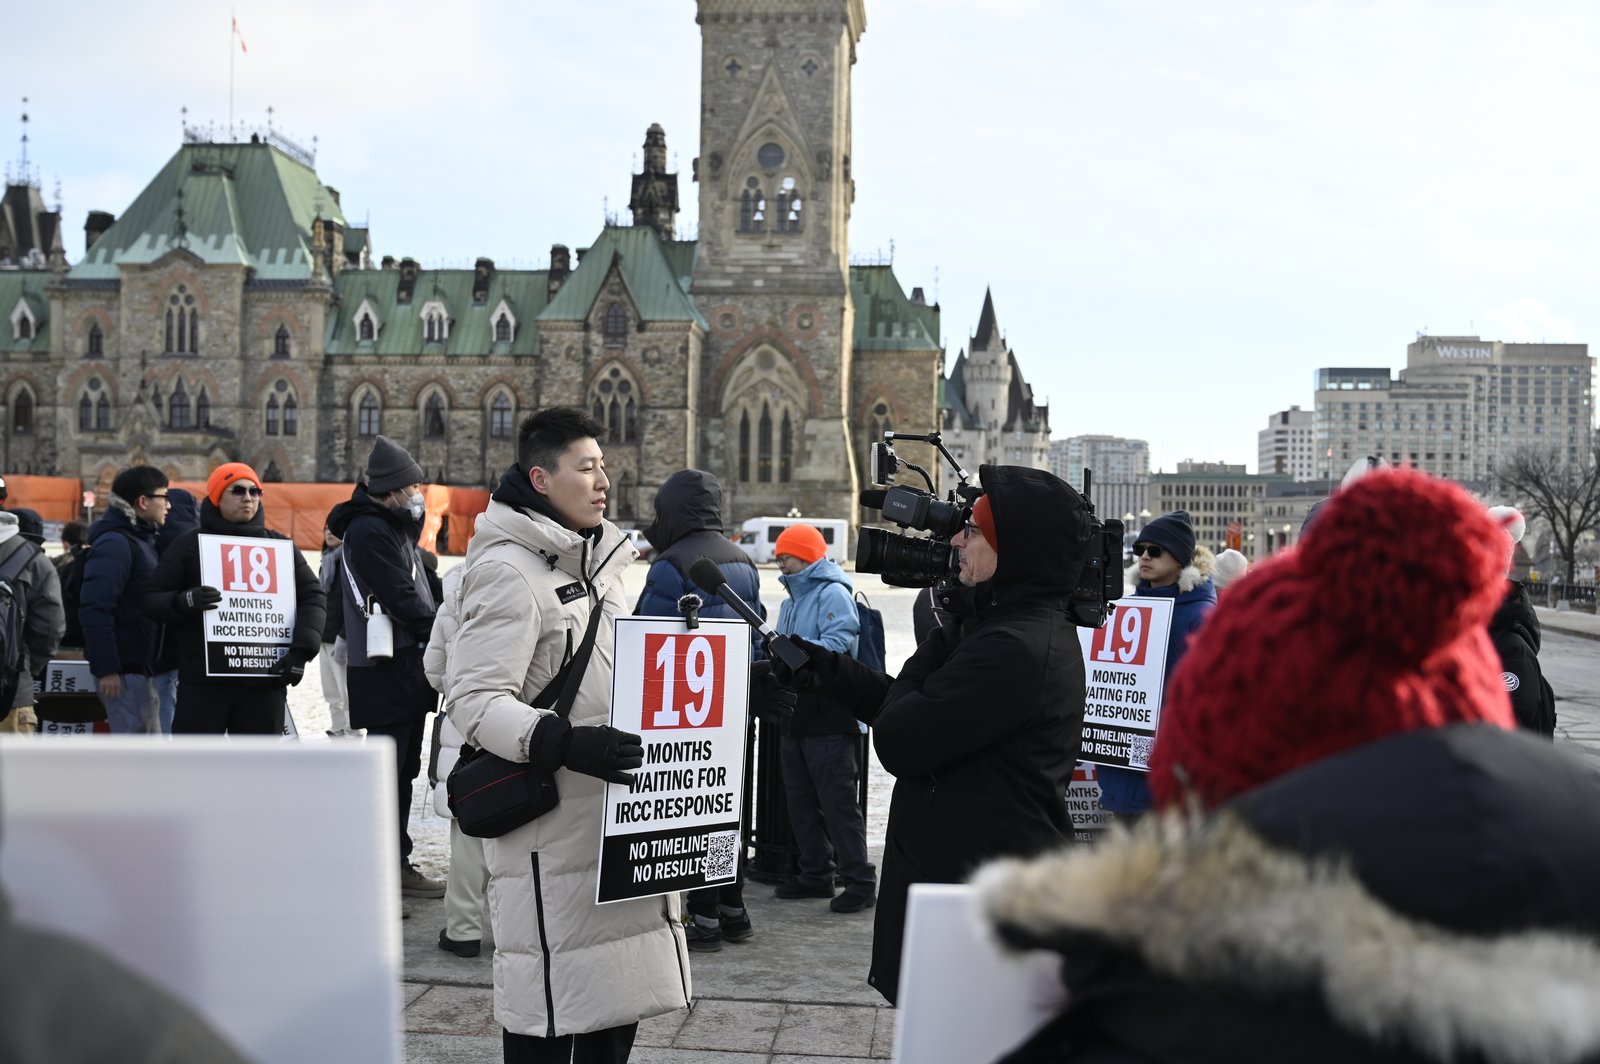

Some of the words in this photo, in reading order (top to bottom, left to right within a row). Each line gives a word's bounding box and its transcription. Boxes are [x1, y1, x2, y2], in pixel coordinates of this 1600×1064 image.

[1436, 345, 1491, 359] WESTIN
[228, 545, 271, 592] 18
[229, 597, 273, 610] MONTHS
[218, 611, 262, 623] WAITING
[265, 613, 285, 624] FOR
[212, 625, 237, 637] IRCC
[237, 626, 291, 638] RESPONSE
[1097, 607, 1142, 664] 19
[224, 646, 237, 656] NO
[228, 658, 242, 668] NO
[653, 636, 714, 727] 19
[1092, 669, 1137, 686] MONTHS
[1125, 690, 1147, 705] FOR
[1095, 703, 1152, 723] RESPONSE
[1092, 728, 1135, 744] TIMELINE
[646, 740, 712, 764] MONTHS
[1081, 741, 1094, 753] NO
[1094, 742, 1131, 759] RESULTS
[629, 768, 694, 794] WAITING
[697, 766, 727, 788] FOR
[1065, 787, 1099, 798] ONTHS
[615, 799, 652, 824] IRCC
[653, 792, 734, 820] RESPONSE
[1065, 800, 1089, 811] TING
[629, 841, 648, 860] NO
[633, 864, 652, 883] NO
[655, 856, 707, 880] RESULTS
